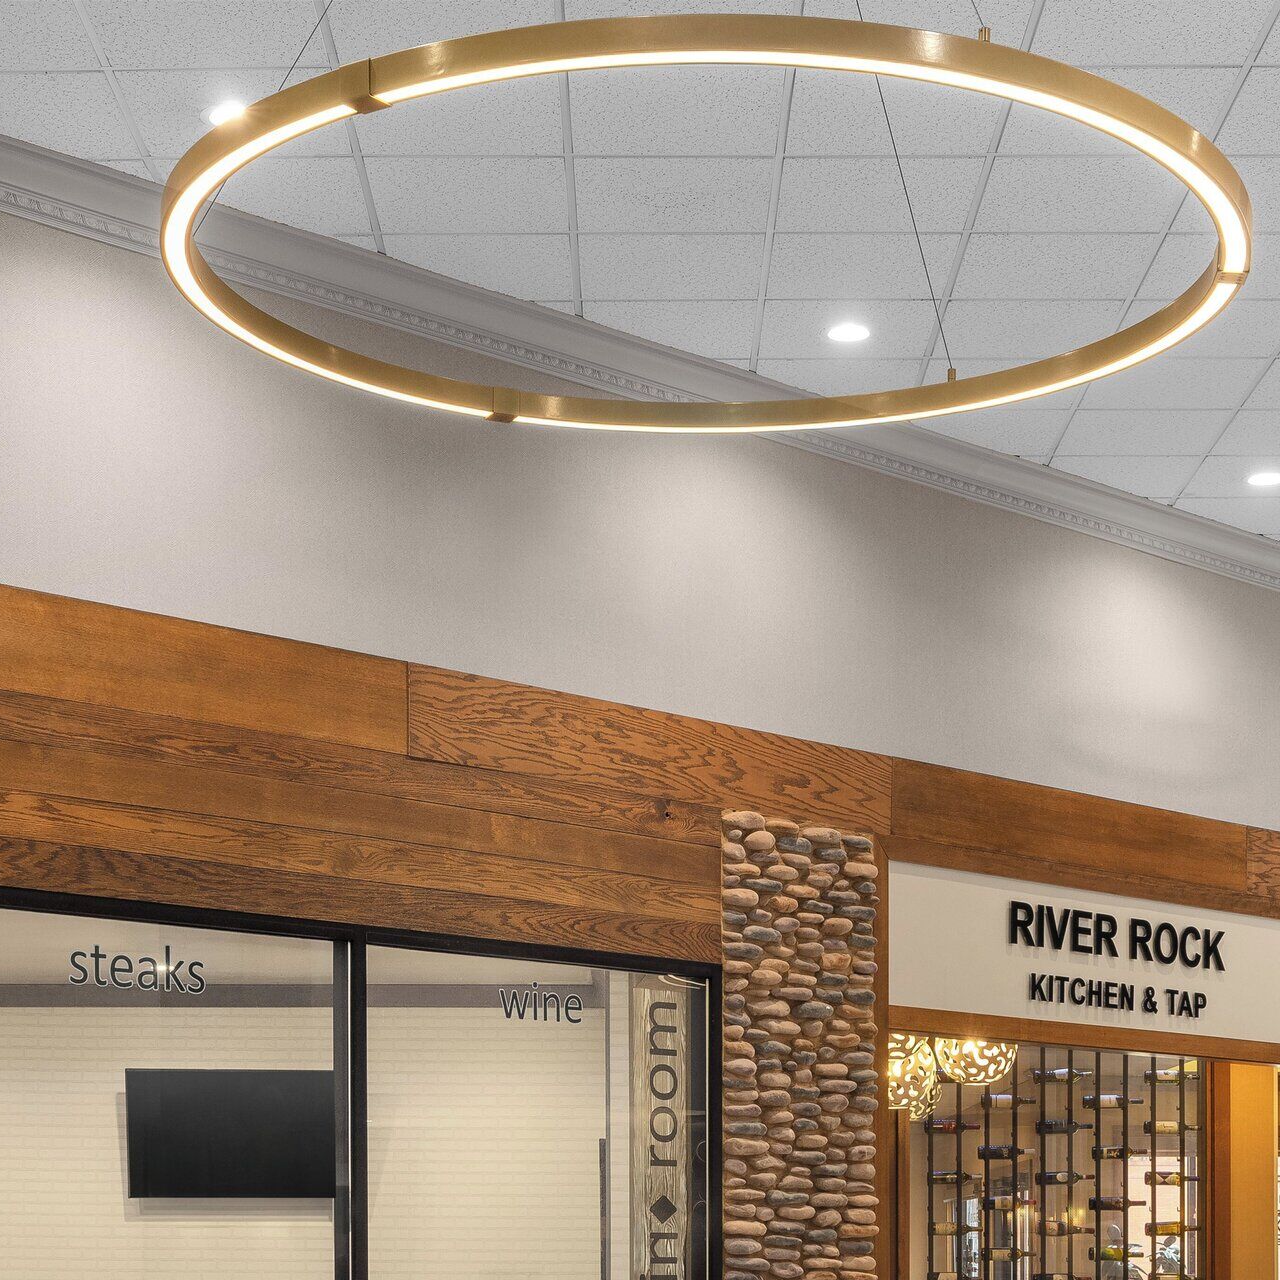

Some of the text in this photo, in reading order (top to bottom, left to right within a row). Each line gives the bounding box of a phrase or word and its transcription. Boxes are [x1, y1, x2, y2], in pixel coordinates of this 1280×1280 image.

[1008, 900, 1226, 972] RIVER ROCK
[68, 945, 207, 994] steaks
[499, 981, 583, 1024] wine
[1029, 972, 1208, 1018] KITCHEN & TAP
[648, 1001, 678, 1167] room
